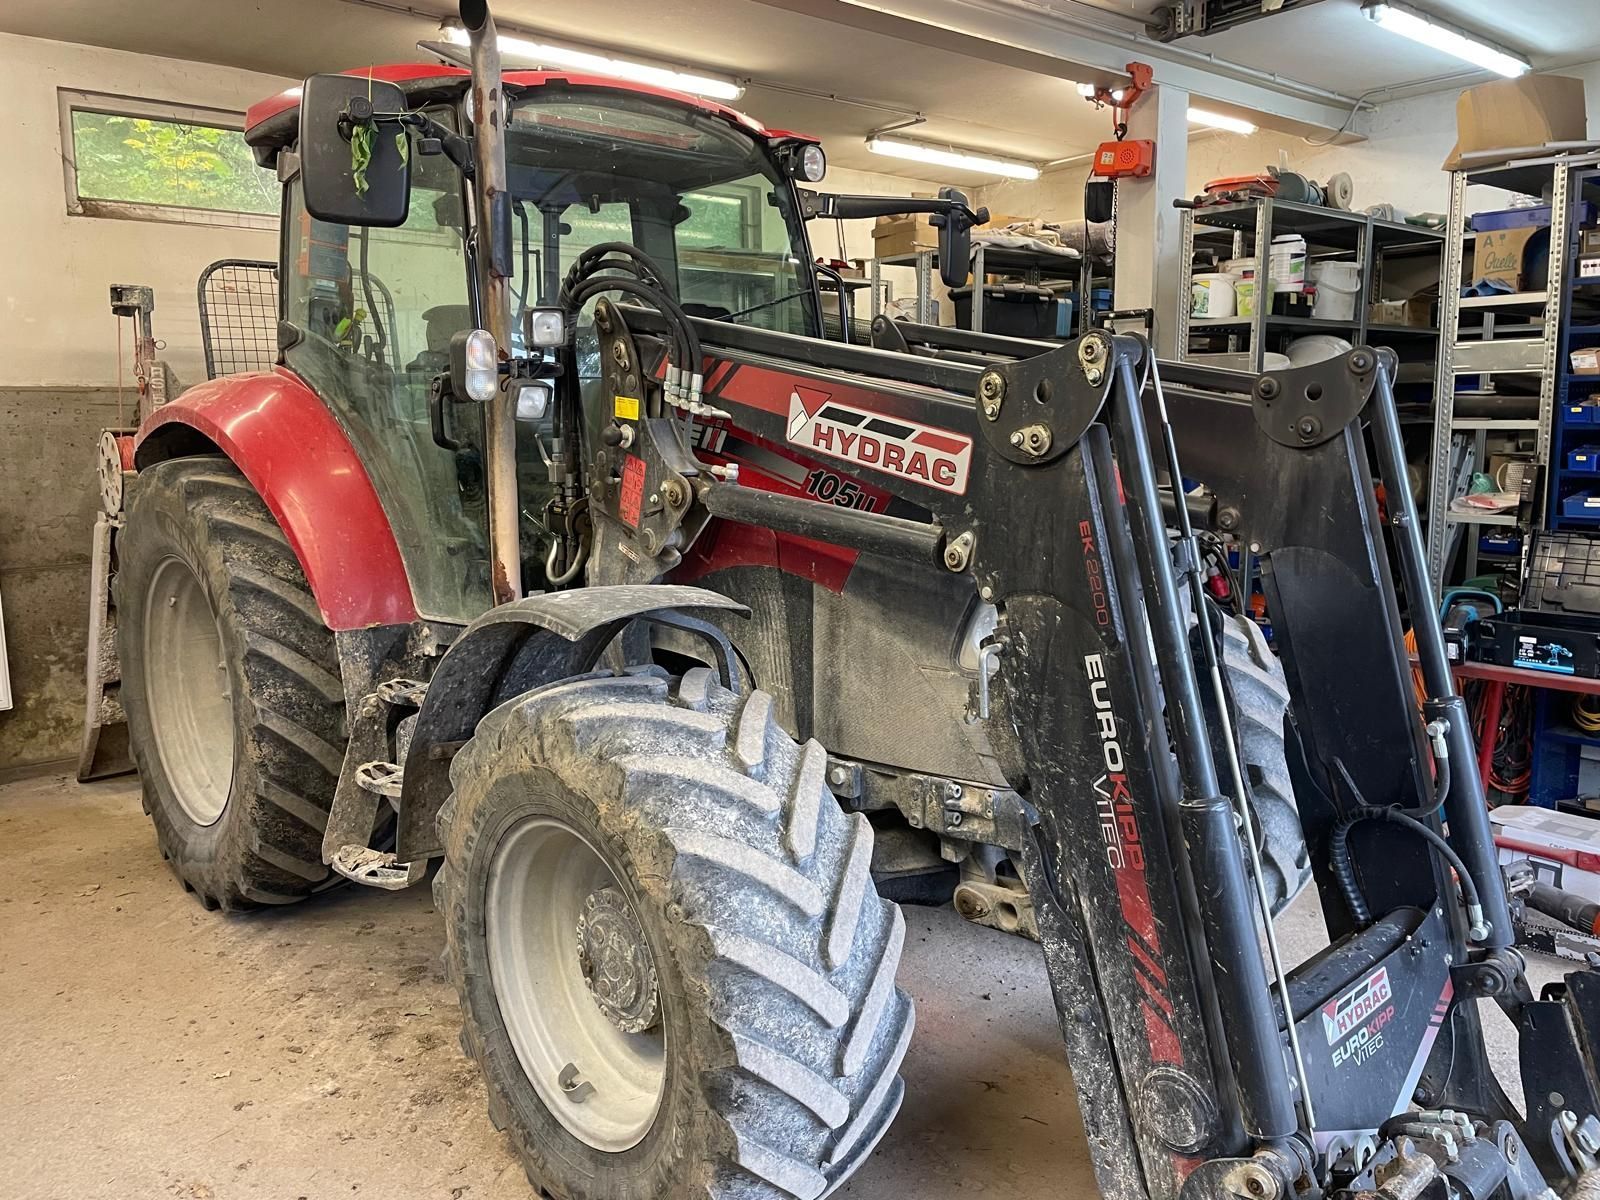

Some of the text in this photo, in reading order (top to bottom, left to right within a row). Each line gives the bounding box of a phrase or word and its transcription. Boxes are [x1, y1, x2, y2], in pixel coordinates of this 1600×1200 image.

[812, 423, 957, 486] HYDRAC
[1079, 520, 1109, 625] EK 2200
[1084, 653, 1145, 871] EUROKIPP
[1331, 1005, 1395, 1068] EUROKIPP
[1336, 983, 1388, 1033] HYDRAC
